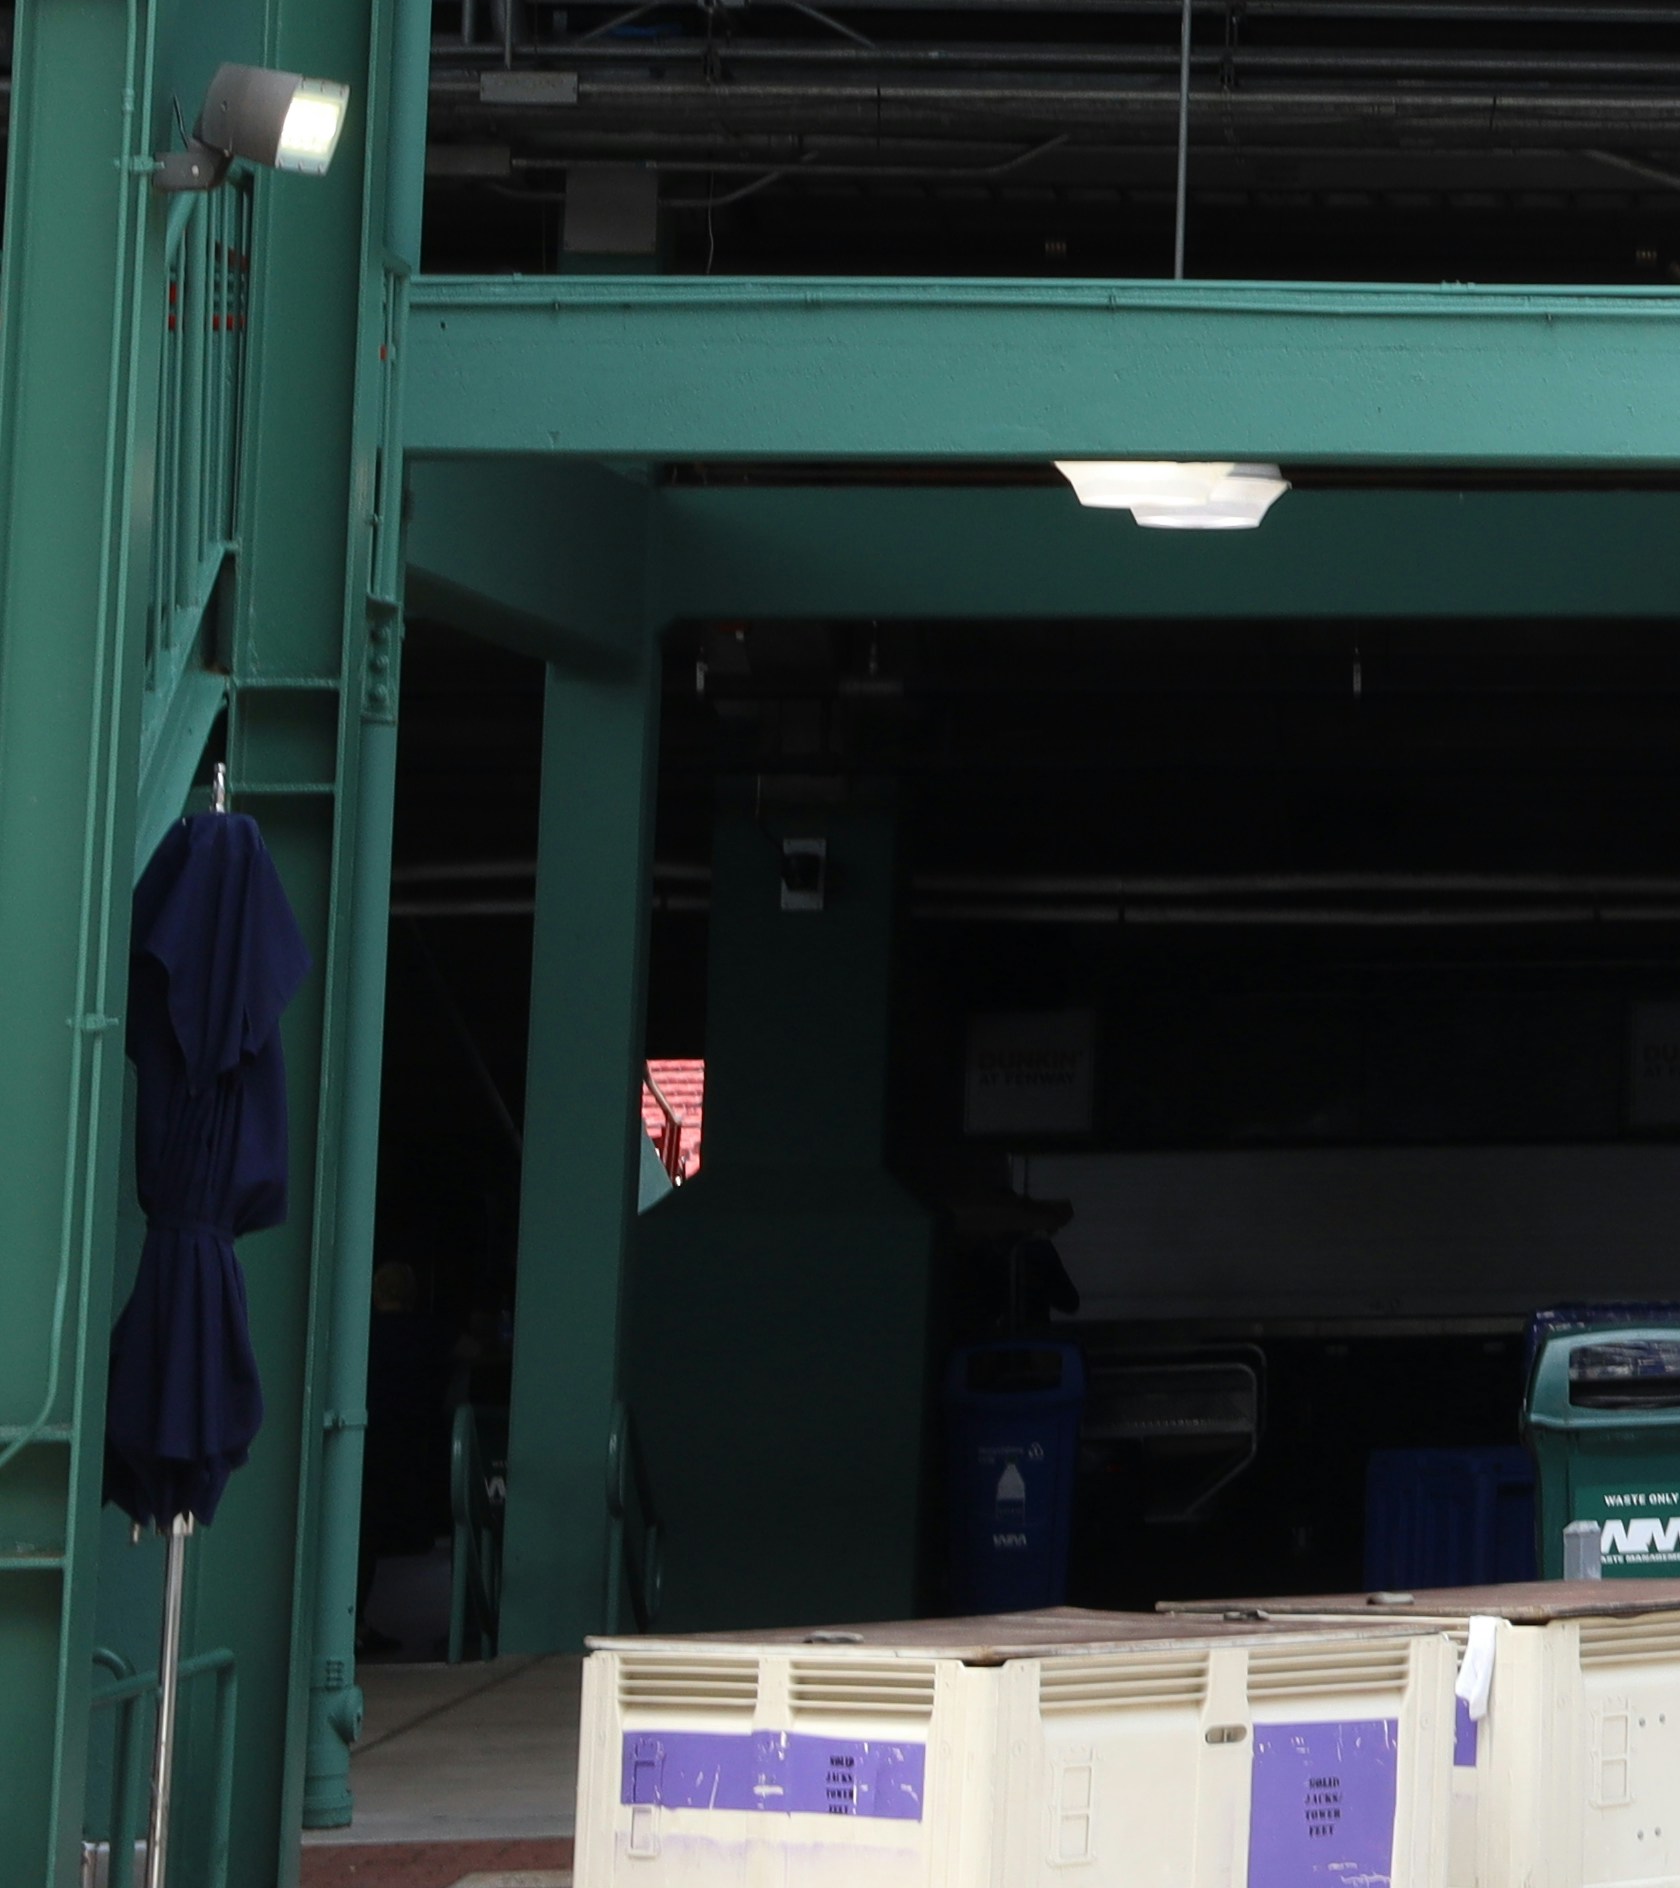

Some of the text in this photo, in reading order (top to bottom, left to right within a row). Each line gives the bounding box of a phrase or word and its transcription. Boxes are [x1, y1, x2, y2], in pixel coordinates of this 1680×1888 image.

[1604, 1492, 1680, 1507] WASTE ONLY
[1601, 1555, 1624, 1564] ASTE
